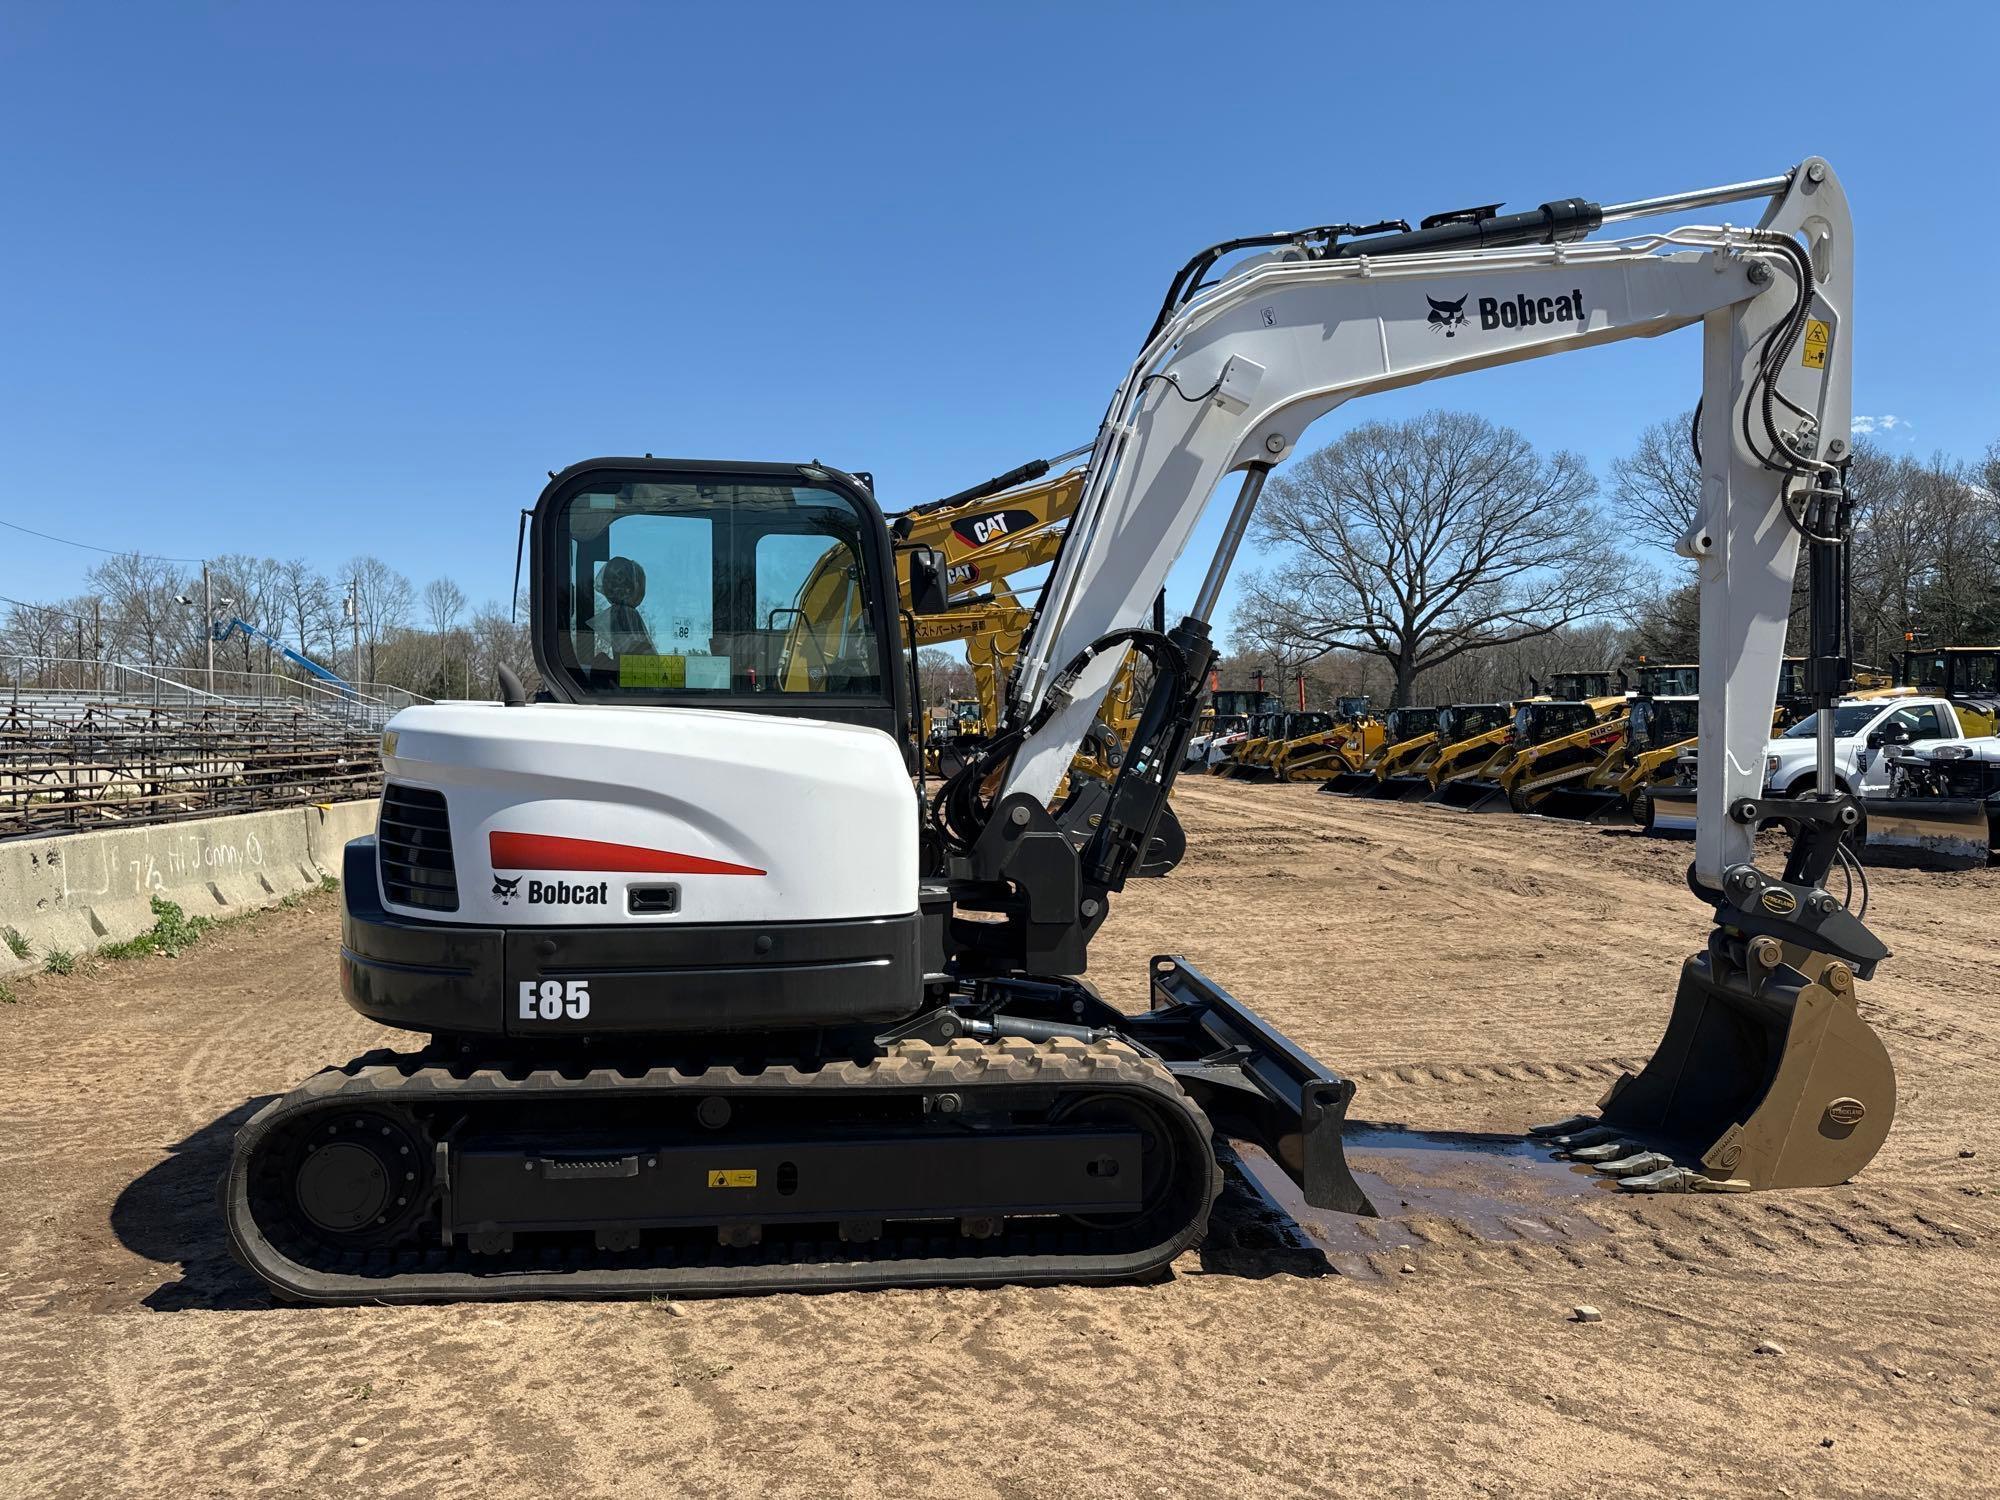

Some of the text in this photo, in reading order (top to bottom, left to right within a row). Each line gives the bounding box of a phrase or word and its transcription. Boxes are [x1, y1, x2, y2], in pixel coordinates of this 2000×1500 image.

[1479, 289, 1585, 330] Bobcat
[974, 513, 1008, 543] CAT
[946, 564, 971, 584] CAT
[528, 880, 608, 905] Bobcat
[519, 980, 590, 1020] E85
